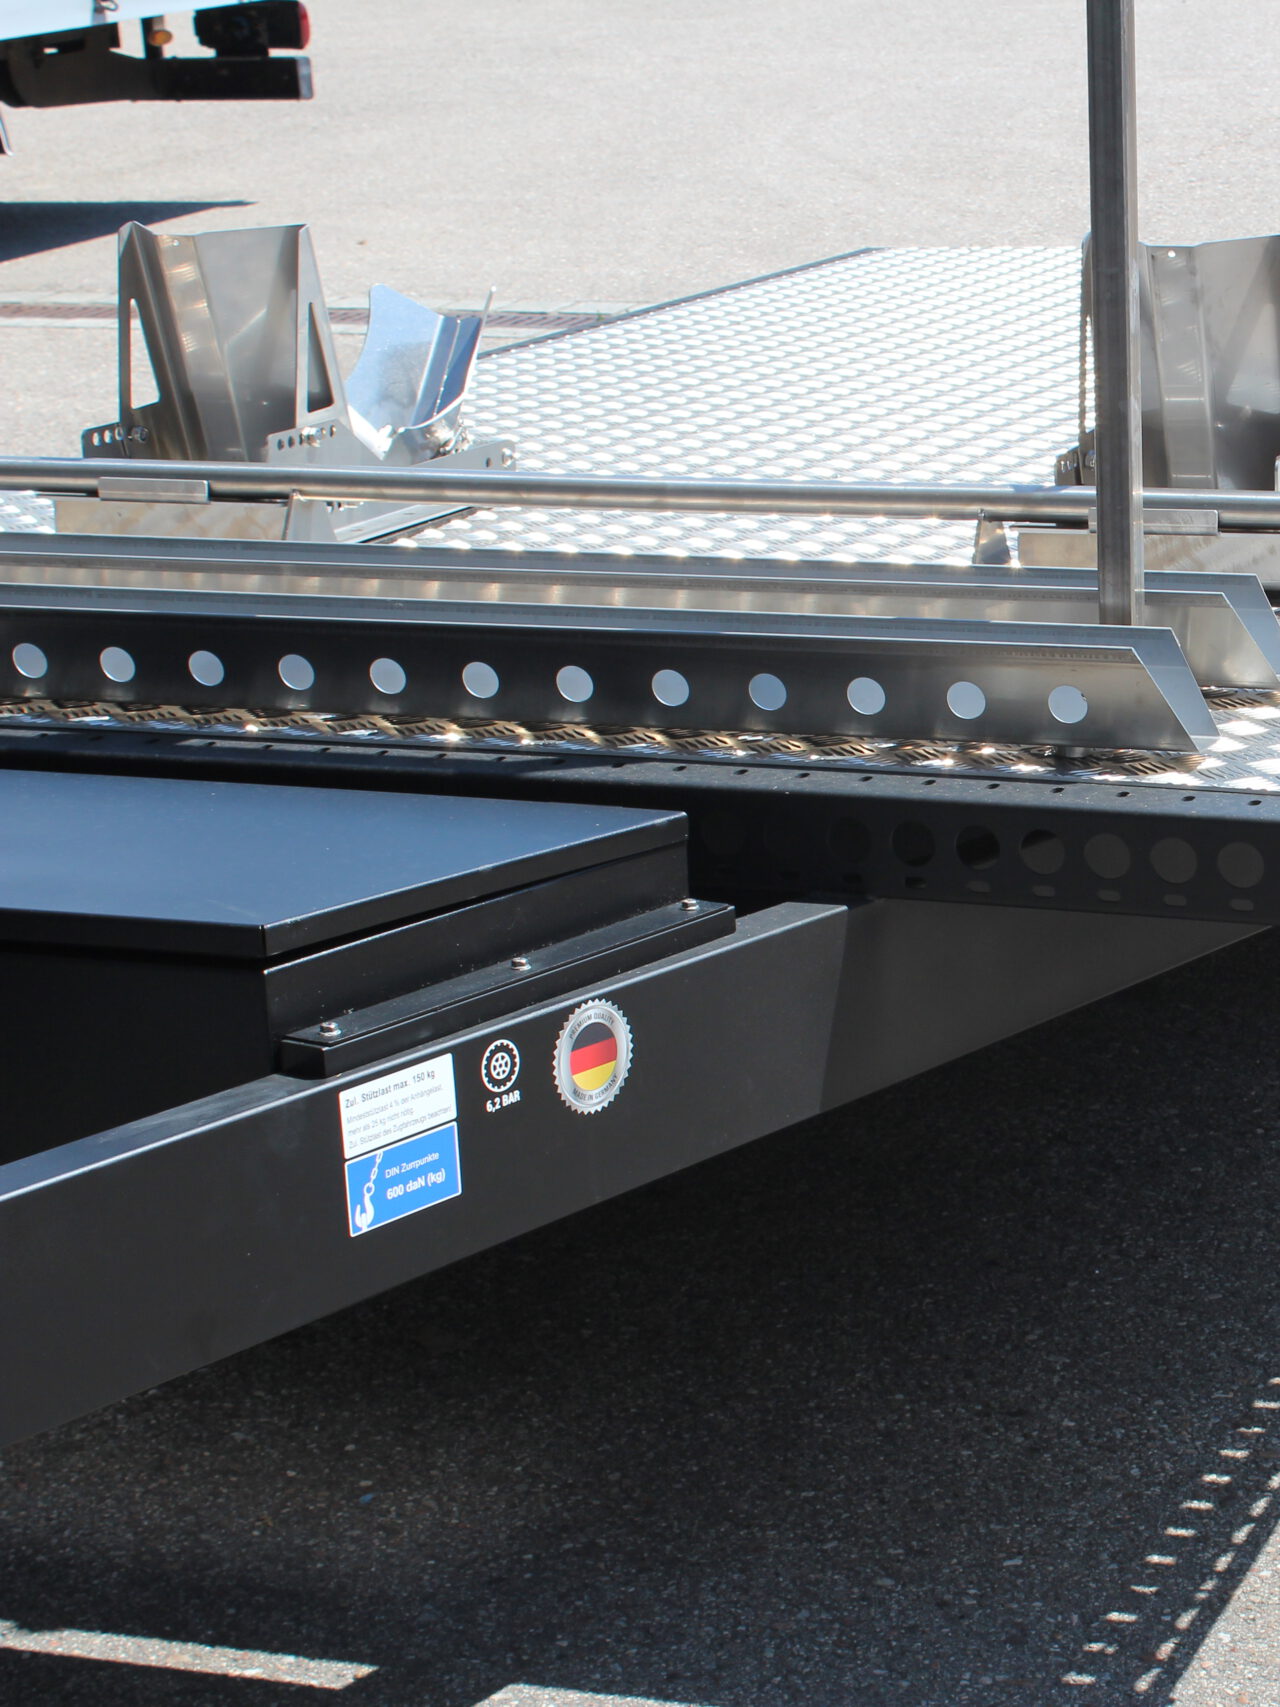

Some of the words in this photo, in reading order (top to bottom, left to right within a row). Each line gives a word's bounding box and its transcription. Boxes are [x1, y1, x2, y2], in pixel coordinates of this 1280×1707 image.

[569, 1013, 593, 1040] PREMIUM
[593, 1012, 615, 1026] QUALITY
[345, 1096, 360, 1109] Zul.
[361, 1085, 392, 1103] Stützlast
[393, 1080, 411, 1091] max.
[412, 1071, 425, 1084] 150
[427, 1070, 435, 1080] kg
[573, 1087, 587, 1101] MADE
[594, 1072, 618, 1100] GERMANY
[486, 1097, 501, 1113] 6,2
[502, 1089, 521, 1107] BAR
[385, 1165, 400, 1179] DIN
[400, 1152, 440, 1173] Zurrpunkte
[386, 1184, 405, 1200] 600
[406, 1175, 426, 1193] daN
[427, 1167, 446, 1187] (kg)
